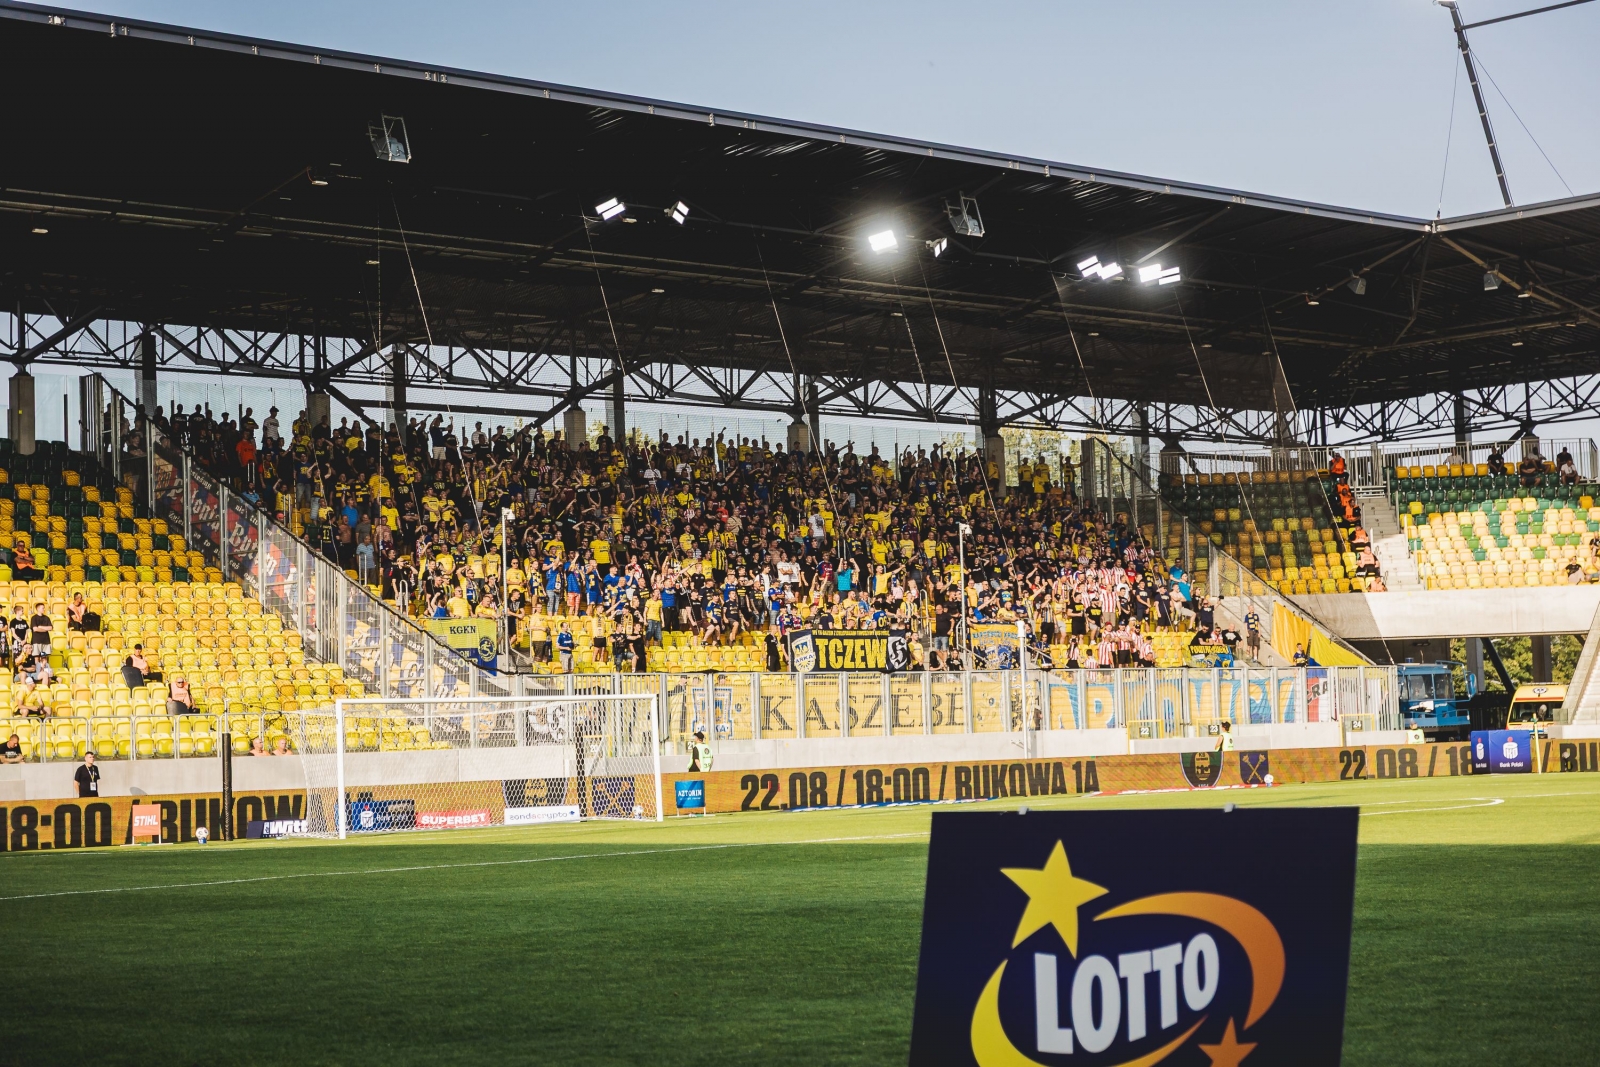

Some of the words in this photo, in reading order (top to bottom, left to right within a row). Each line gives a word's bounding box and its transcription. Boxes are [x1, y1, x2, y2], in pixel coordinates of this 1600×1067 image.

[815, 638, 888, 669] TCZEW
[1353, 720, 1362, 728] 24
[1339, 748, 1418, 780] 22.08
[1559, 742, 1600, 773] BU
[740, 771, 828, 812] 22.08
[853, 766, 930, 805] 18:00
[954, 762, 1068, 800] BUKOWA
[1072, 760, 1100, 794] 1A
[133, 815, 159, 827] STIHL
[421, 812, 486, 826] SUPERBET
[1033, 932, 1220, 1055] LOTTO
